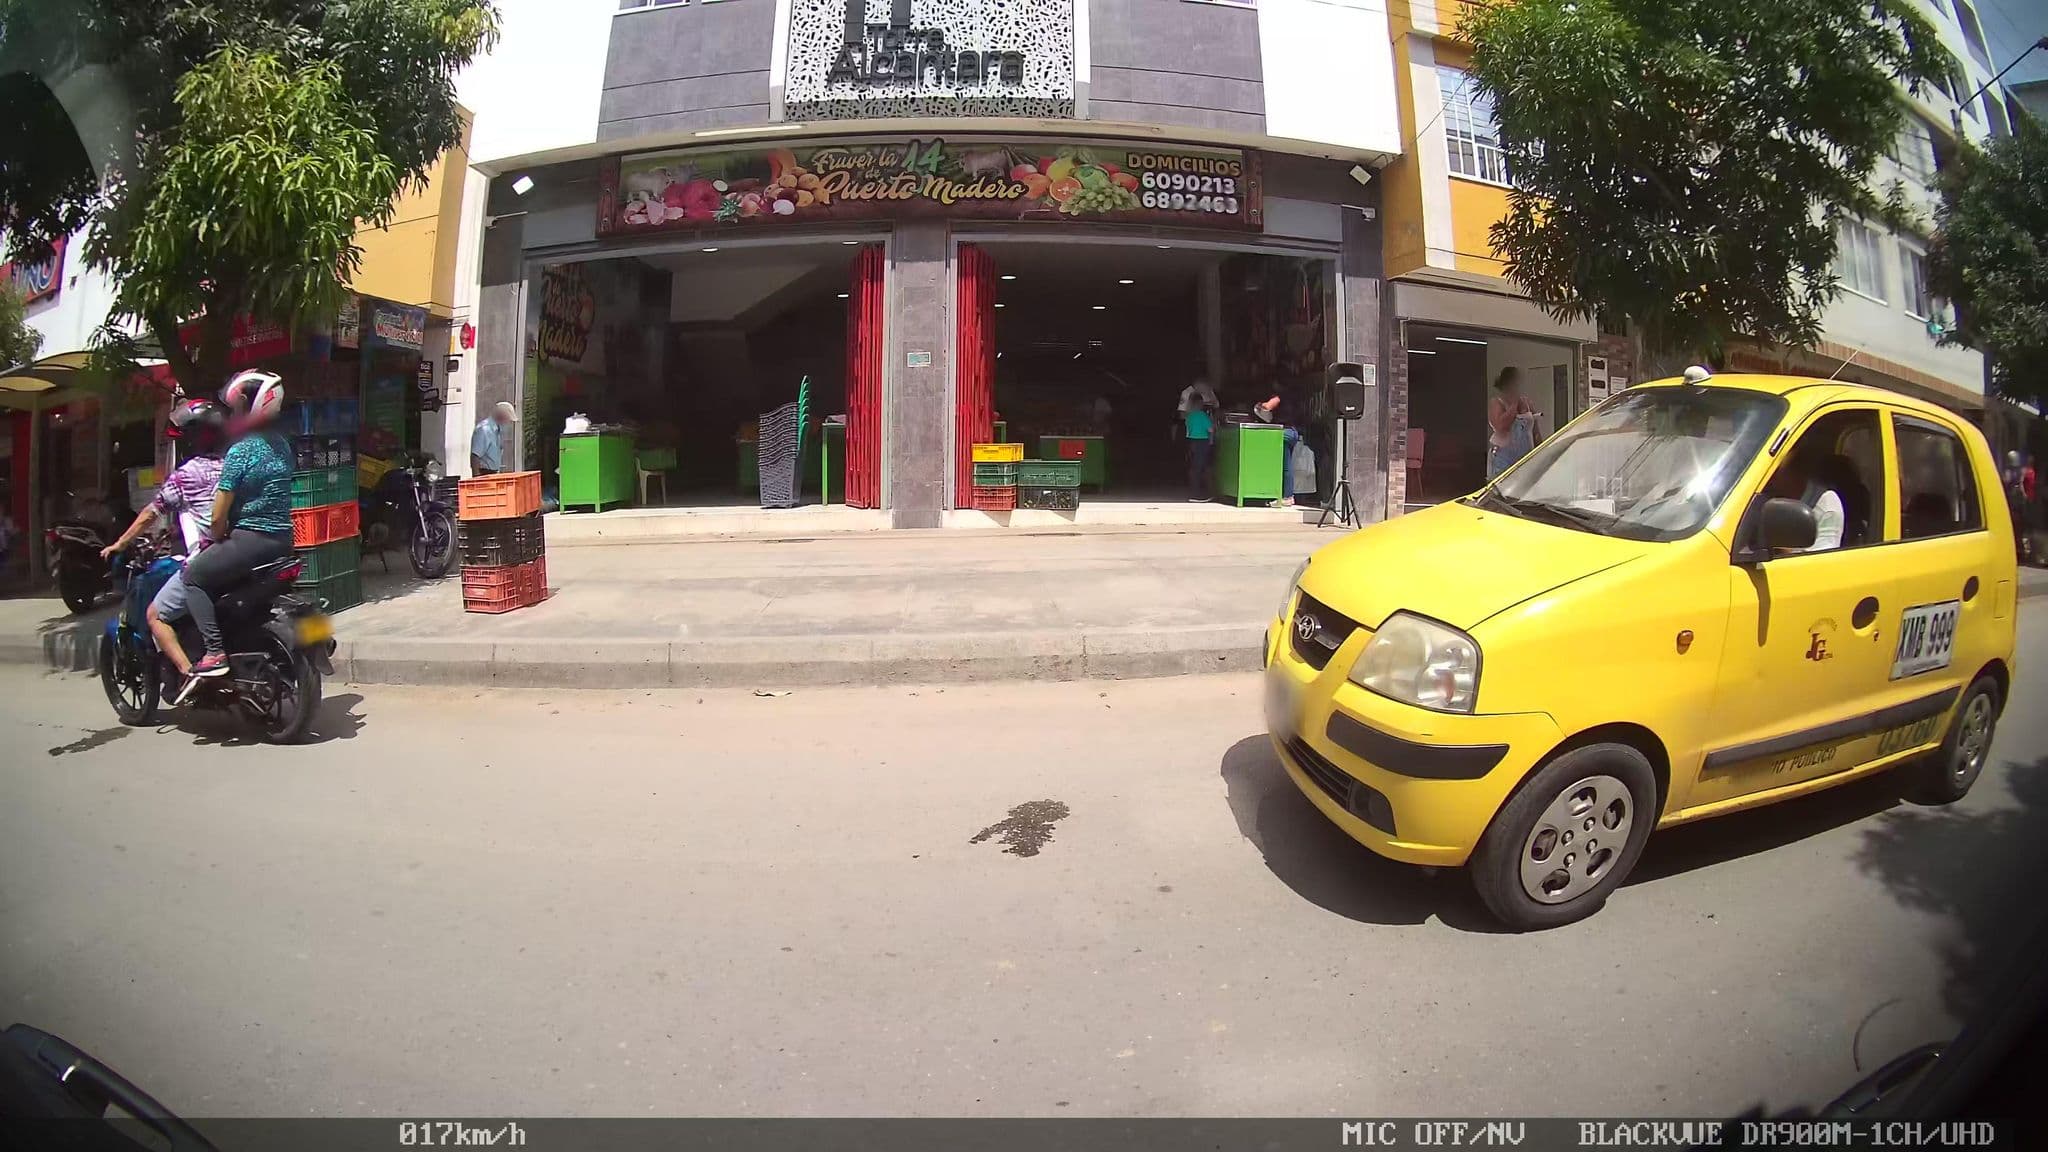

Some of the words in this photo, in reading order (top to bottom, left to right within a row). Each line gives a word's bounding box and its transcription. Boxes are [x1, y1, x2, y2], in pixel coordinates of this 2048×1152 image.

[811, 148, 874, 175] Fruver
[878, 147, 897, 168] la
[902, 138, 946, 175] 14
[1127, 152, 1242, 177] DOMICILIOS
[820, 169, 921, 201] Puerto
[921, 174, 1027, 205] Madero
[865, 166, 881, 180] de
[1141, 171, 1236, 195] 6090213
[1926, 608, 1955, 656] 999
